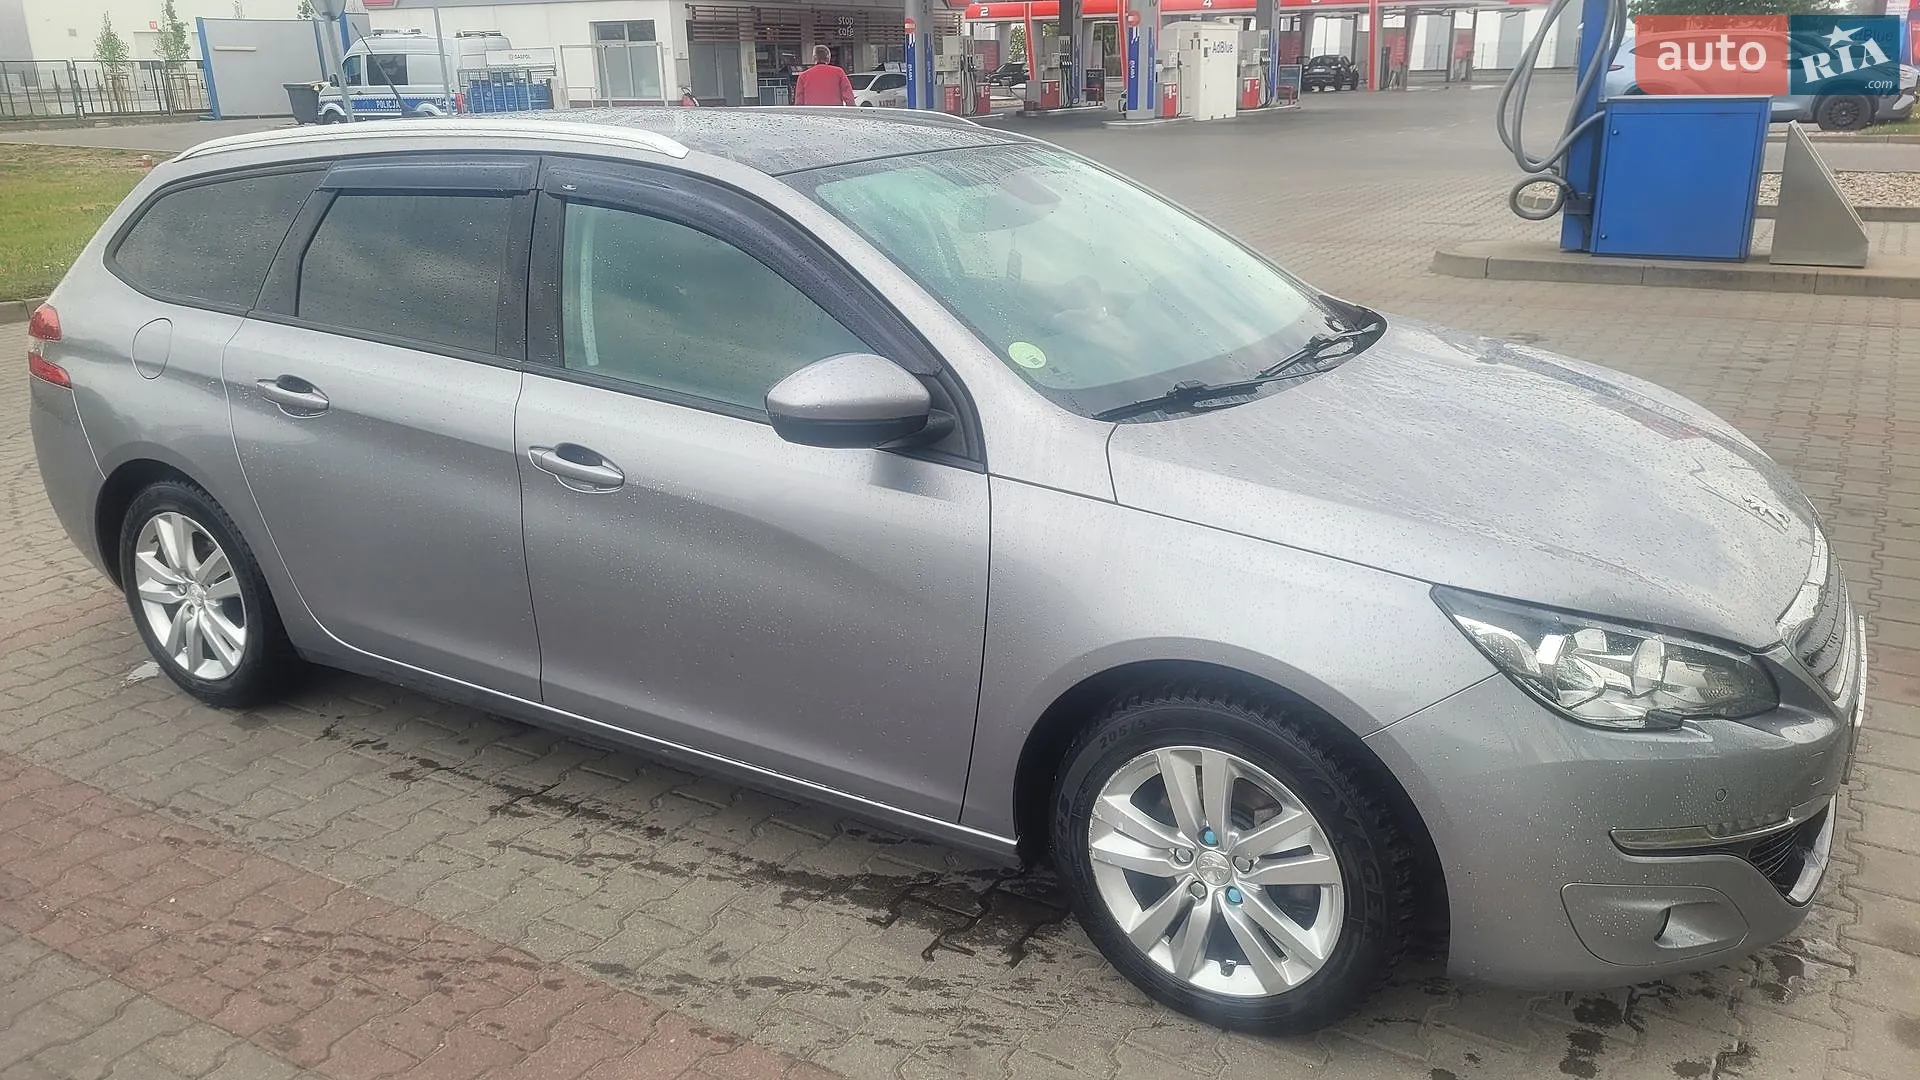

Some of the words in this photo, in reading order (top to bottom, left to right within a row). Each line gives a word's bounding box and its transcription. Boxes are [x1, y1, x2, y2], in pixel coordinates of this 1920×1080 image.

[980, 7, 989, 16] 2
[838, 16, 854, 26] stop
[838, 25, 854, 37] cafe
[1190, 39, 1201, 50] 11
[1211, 41, 1233, 53] AdBlue
[376, 100, 401, 109] POLICJA
